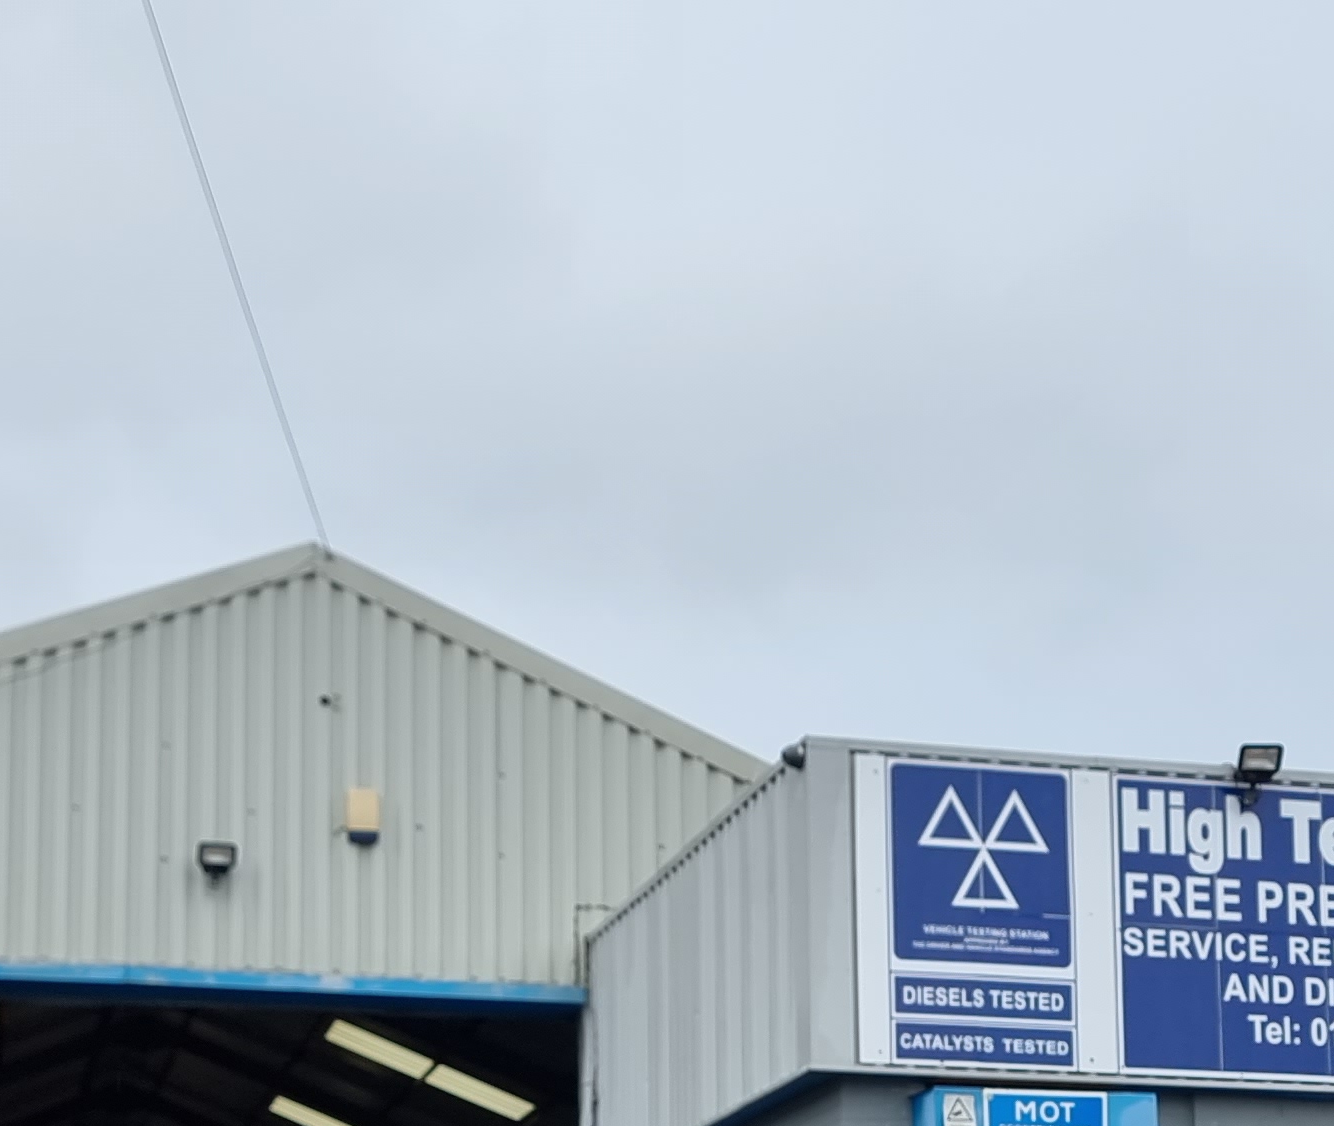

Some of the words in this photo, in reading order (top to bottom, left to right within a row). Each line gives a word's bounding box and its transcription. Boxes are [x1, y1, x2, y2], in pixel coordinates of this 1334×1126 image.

[1121, 787, 1262, 874] High
[1125, 872, 1243, 921] FREE
[1123, 927, 1279, 968] SERVICE,
[902, 985, 985, 1008] DIESELS
[989, 989, 1065, 1012] TESTED
[1223, 973, 1295, 1004] AND
[900, 1032, 994, 1053] CATALYSTS
[1002, 1038, 1069, 1056] TESTED
[1247, 1014, 1301, 1045] Tel:
[1014, 1100, 1076, 1122] MOT
